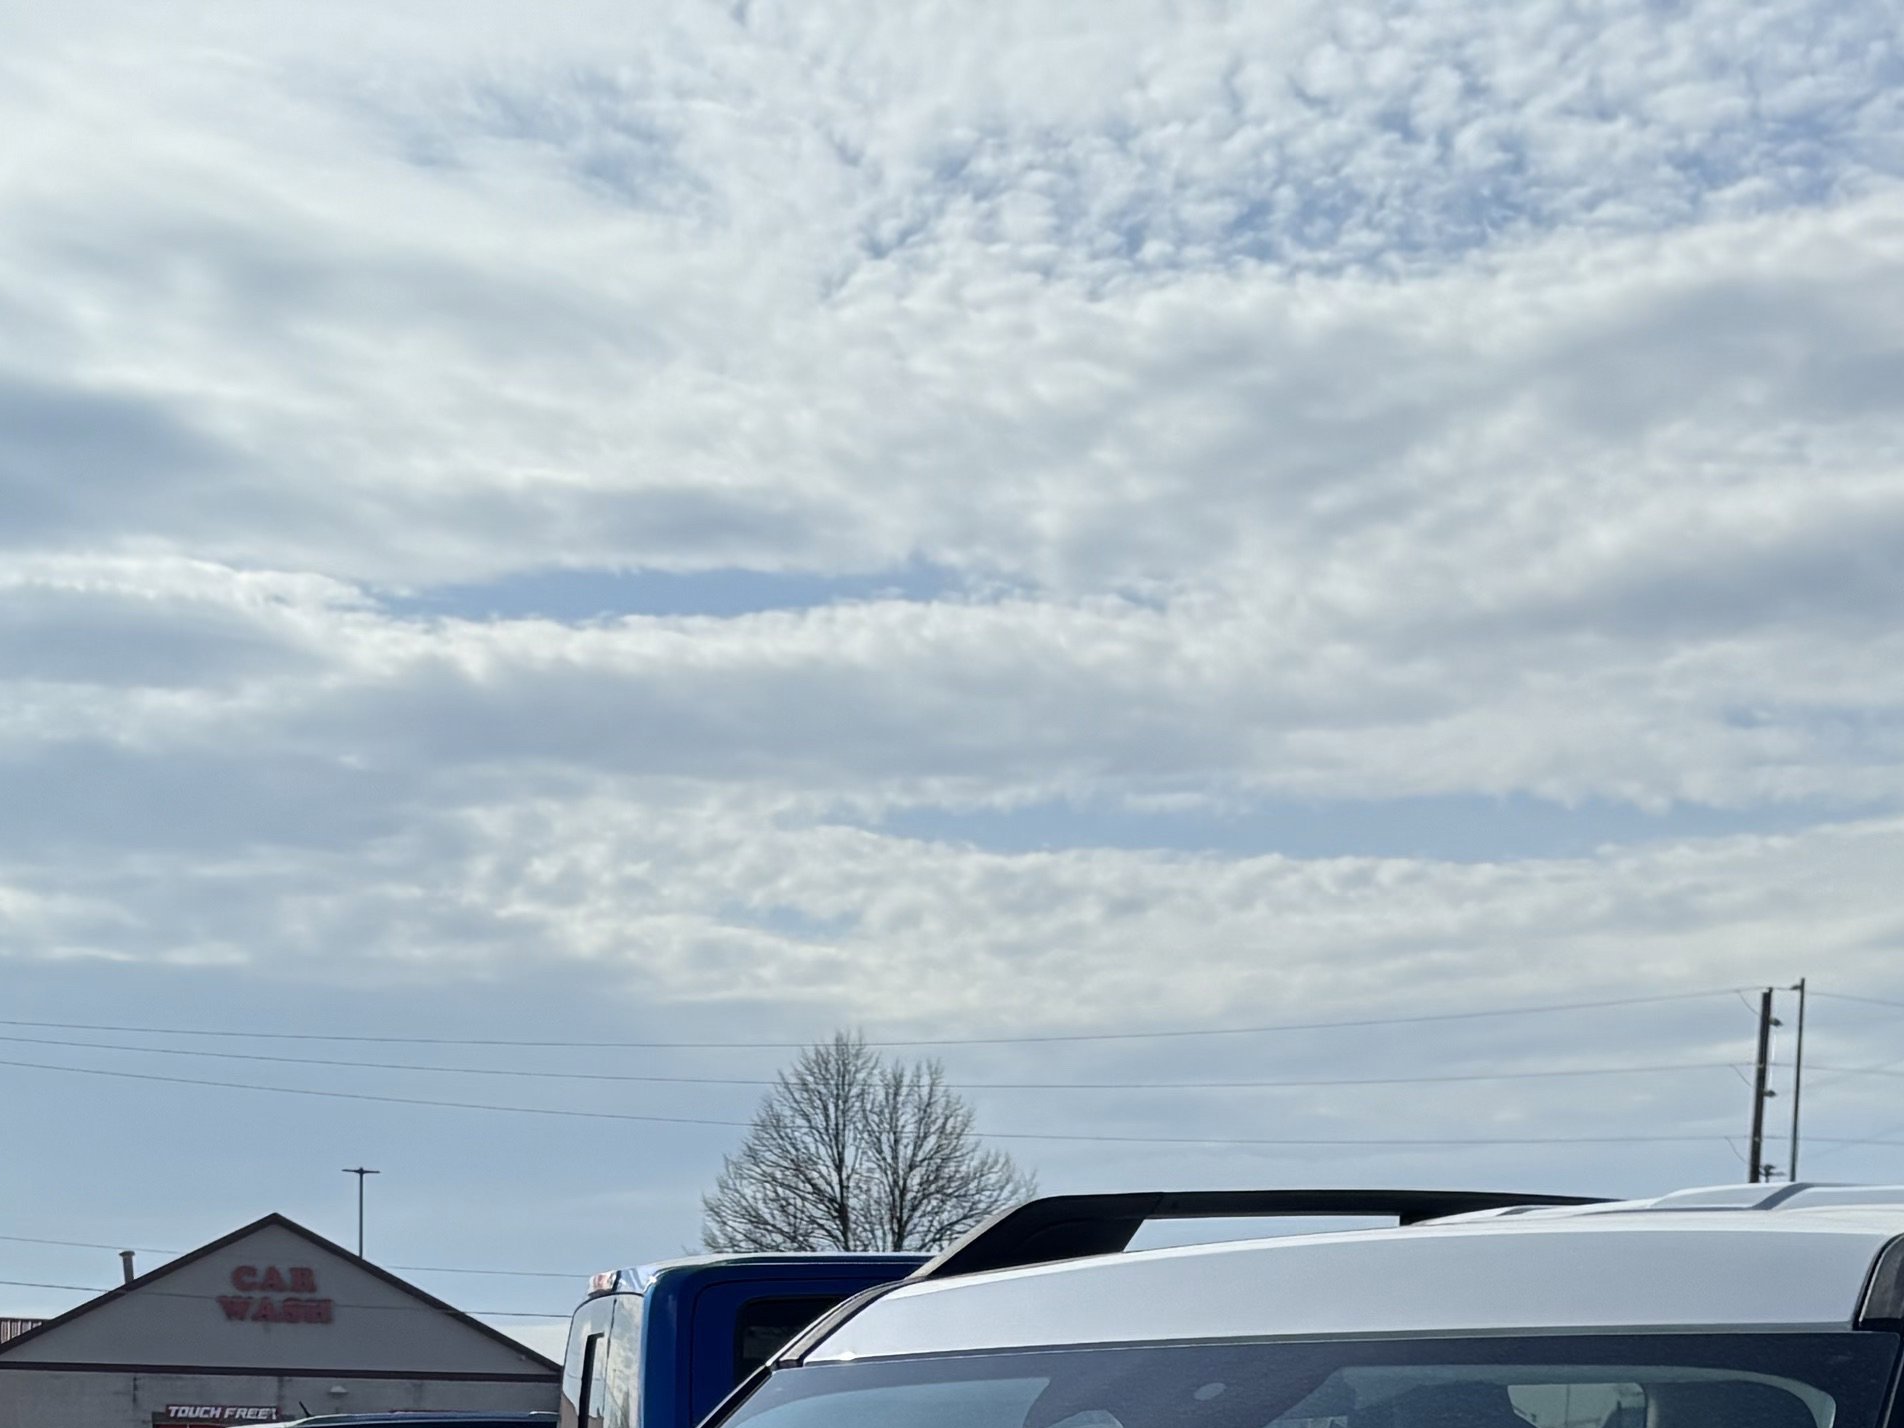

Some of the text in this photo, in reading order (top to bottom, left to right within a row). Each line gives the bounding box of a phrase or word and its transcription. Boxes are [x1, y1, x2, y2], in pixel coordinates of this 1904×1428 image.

[231, 1265, 318, 1293] CAR
[217, 1296, 333, 1324] WASH
[168, 1406, 222, 1418] TOUCH
